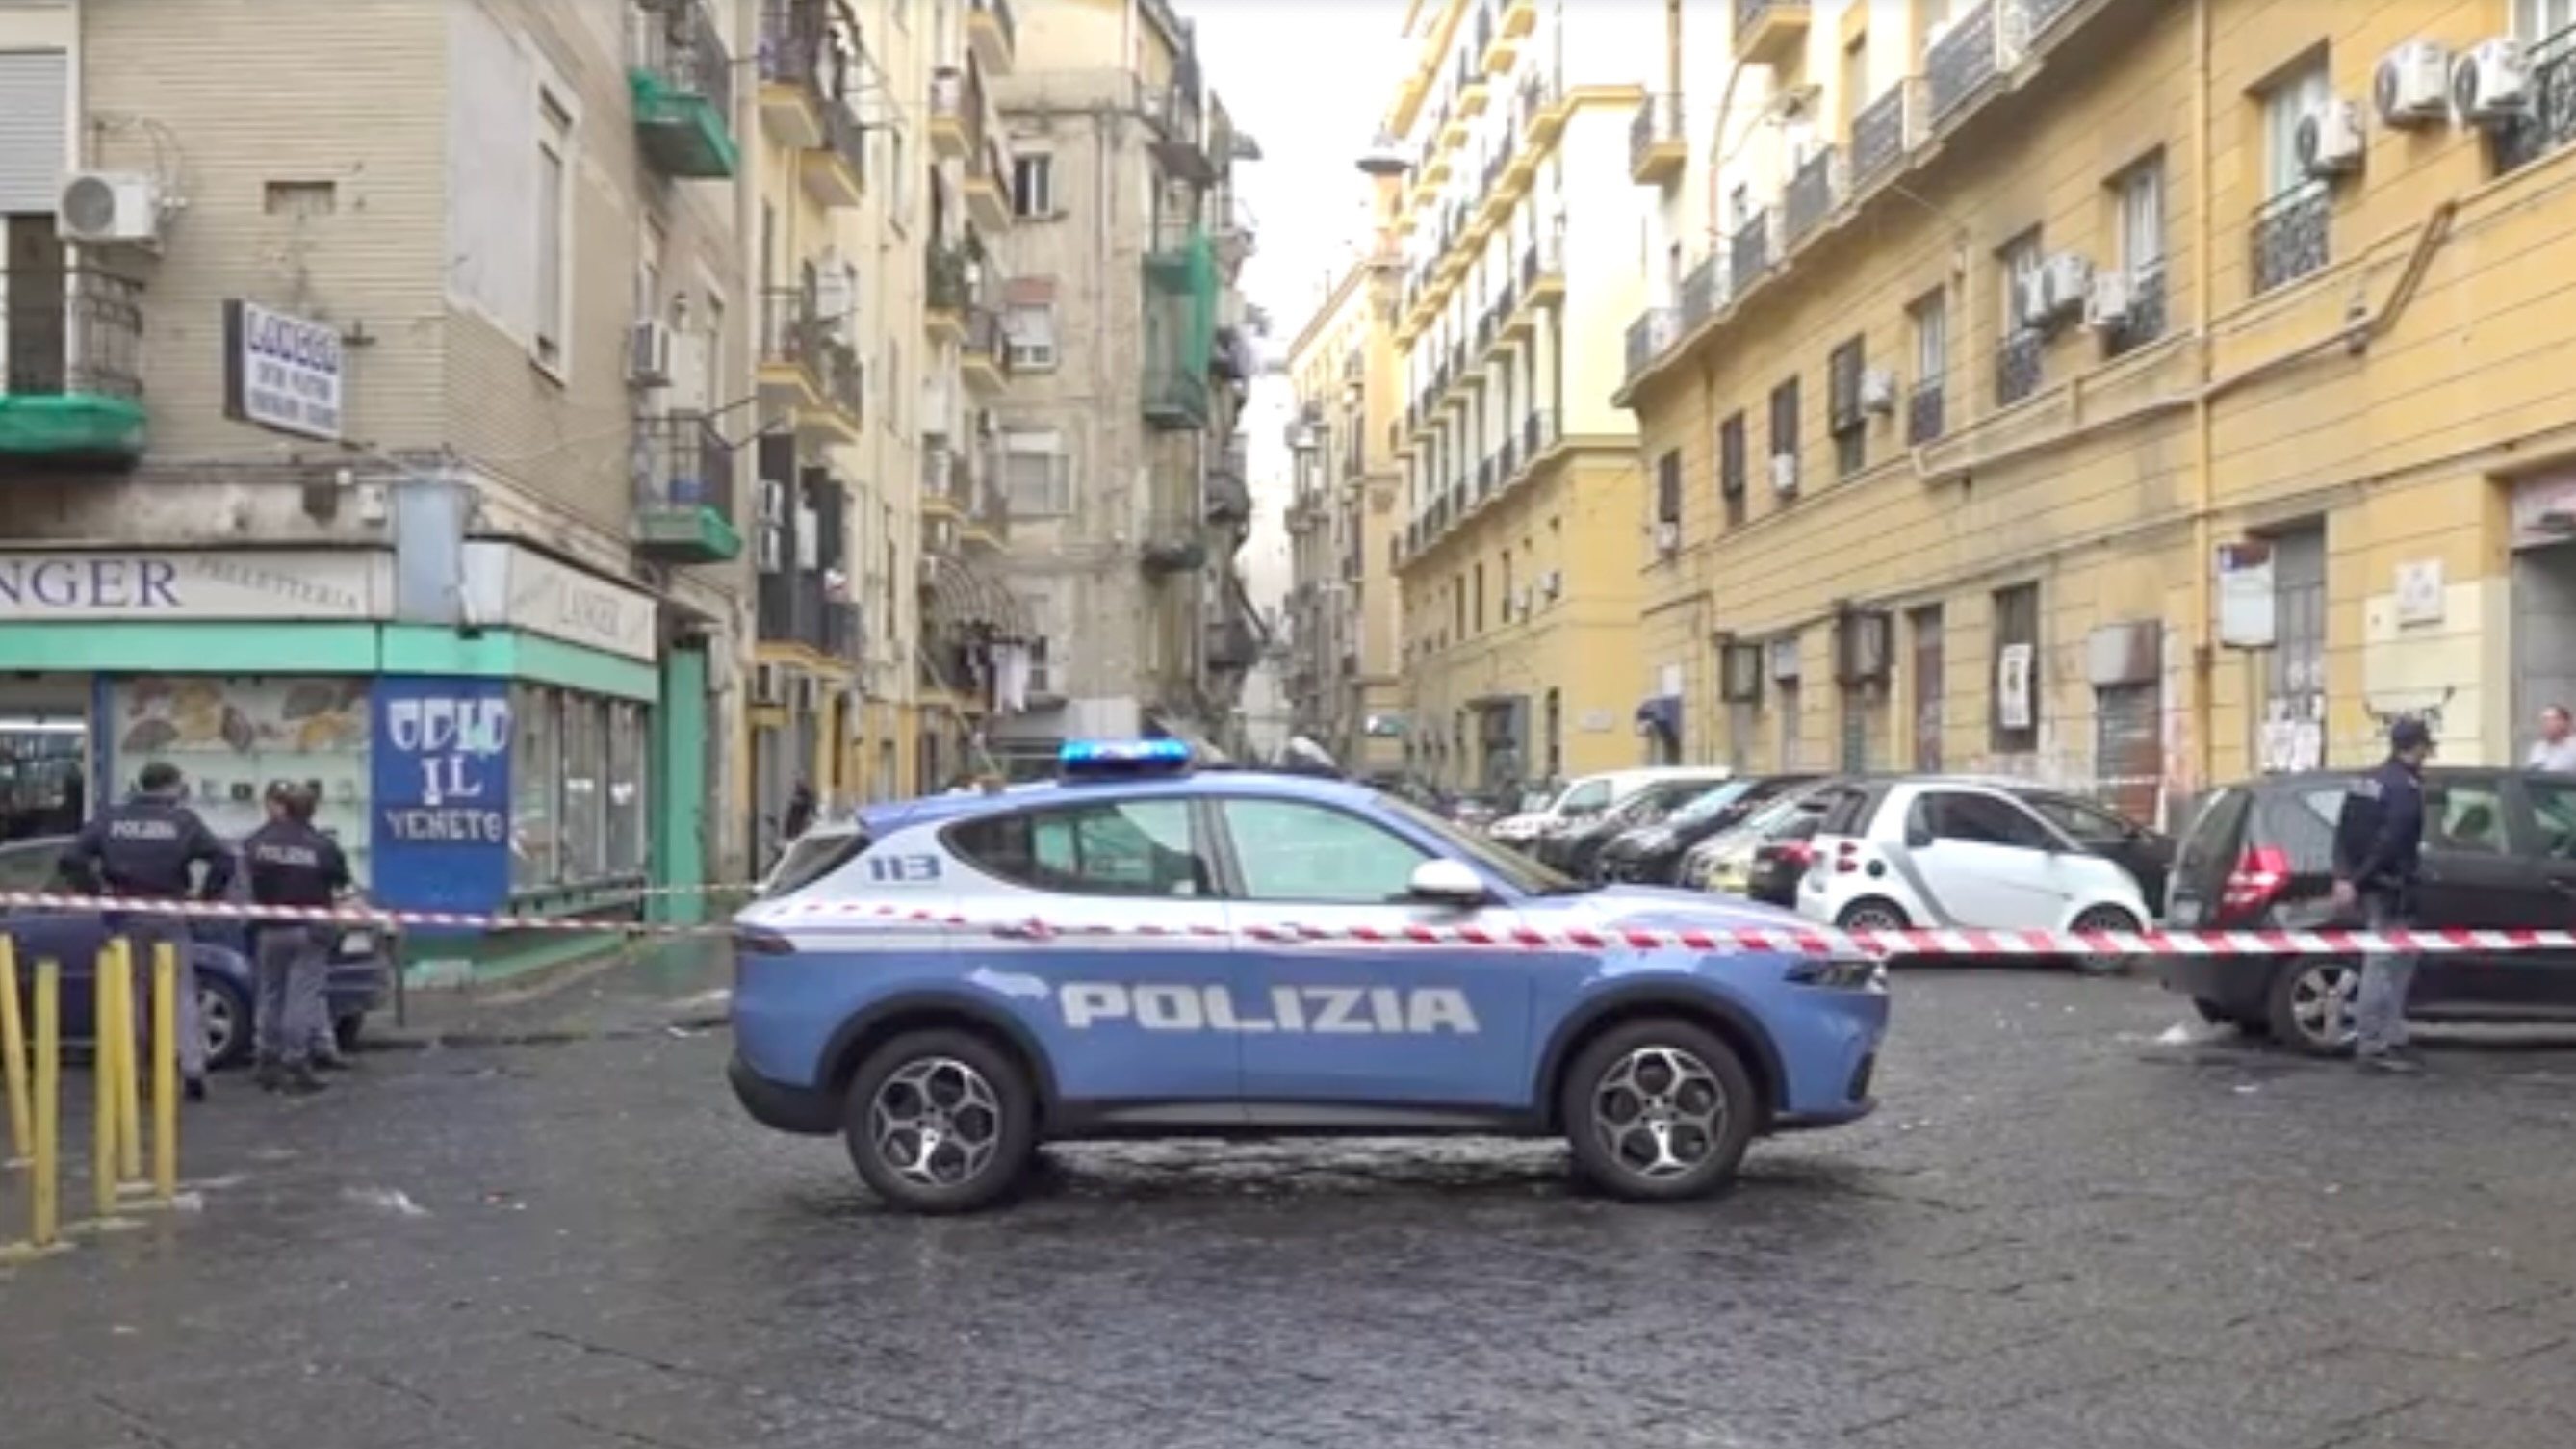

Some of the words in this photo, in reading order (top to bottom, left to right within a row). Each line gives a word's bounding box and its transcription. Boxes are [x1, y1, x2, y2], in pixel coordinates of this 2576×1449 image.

[421, 754, 483, 805] IL
[869, 853, 942, 882] 113
[1060, 983, 1480, 1033] POLIZIA
